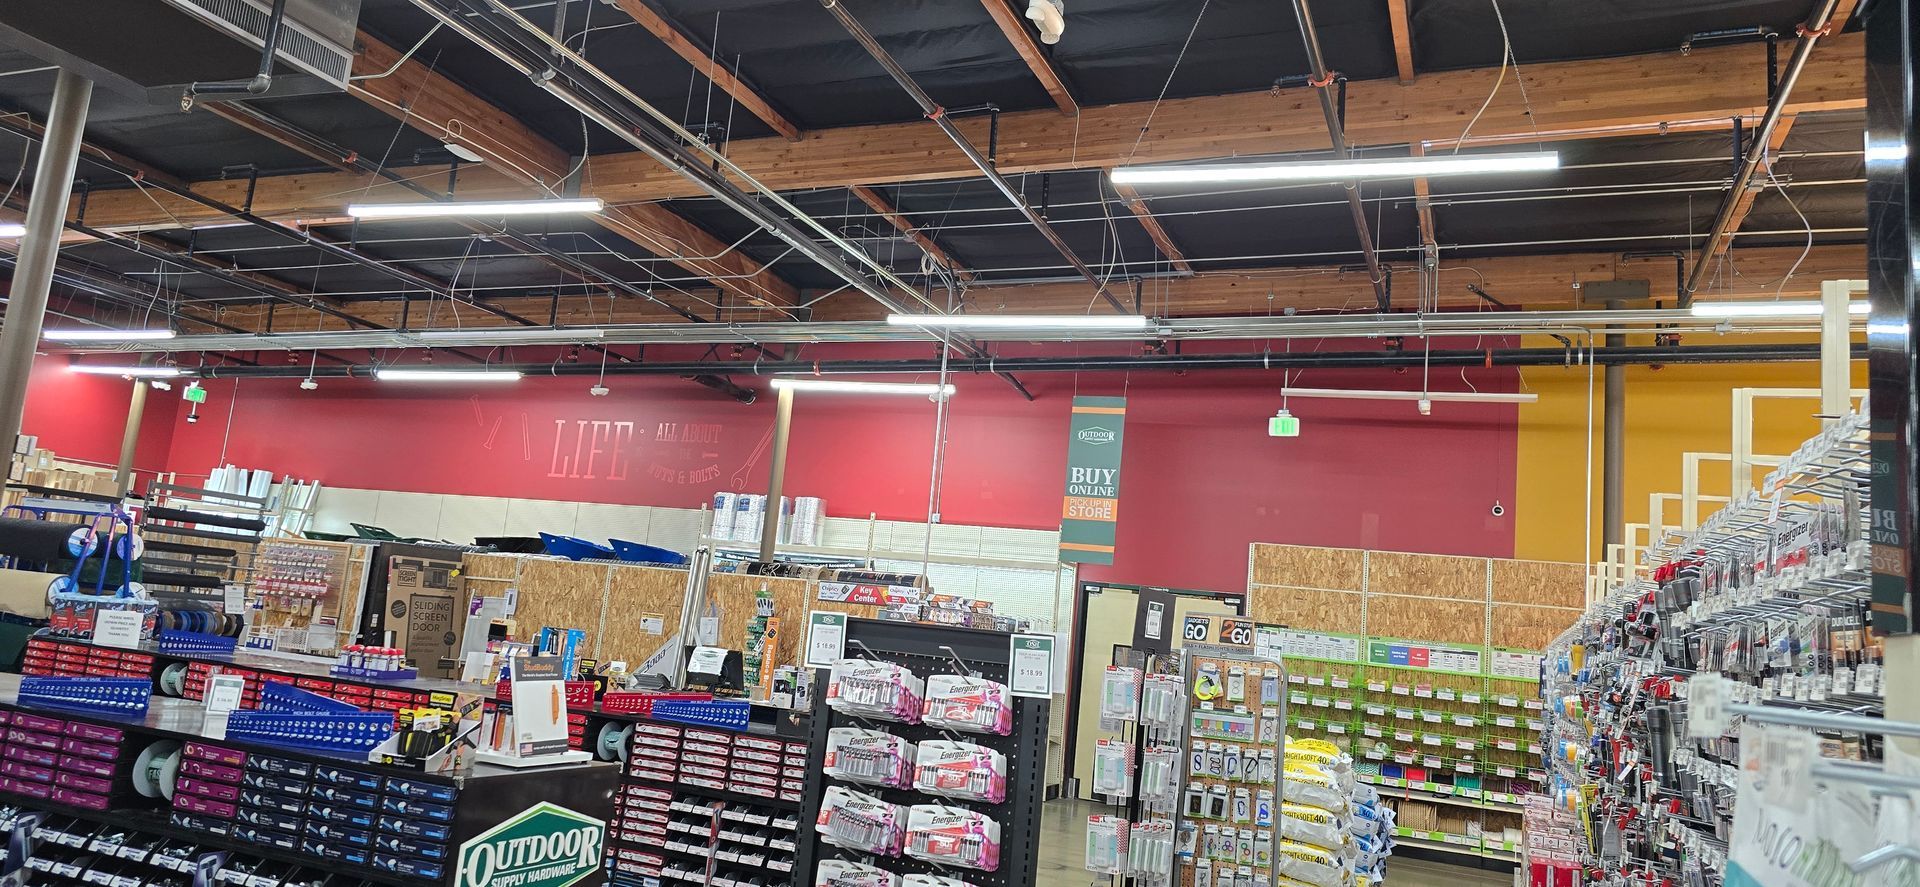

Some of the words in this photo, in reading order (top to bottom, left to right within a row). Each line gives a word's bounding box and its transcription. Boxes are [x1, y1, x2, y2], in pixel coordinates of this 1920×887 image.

[655, 423, 677, 441] ALL
[681, 423, 722, 443] ABOUT
[1078, 430, 1115, 440] OUTDOOR
[547, 419, 634, 480] LIFE
[649, 463, 674, 484] NUTS
[678, 473, 686, 483] &
[689, 464, 721, 484] BOLTS
[1070, 467, 1116, 485] BUY
[1069, 484, 1115, 497] ONLINE
[1069, 498, 1088, 507] PICK
[1069, 505, 1111, 519] STORE
[1778, 522, 1809, 546] Energizer
[859, 586, 873, 594] Key
[854, 594, 877, 603] Center
[414, 601, 450, 611] SLIDING
[414, 612, 448, 621] SCREEN
[413, 623, 440, 632] DOOR
[1185, 625, 1206, 640] GO
[1222, 621, 1235, 638] 2
[1232, 629, 1251, 645] GO
[764, 644, 774, 675] Replace
[523, 663, 555, 673] StudBuddy
[853, 666, 883, 676] Energizer
[950, 685, 980, 694] Energizer
[849, 736, 880, 747] Energizer
[940, 750, 971, 760] Energizer
[1317, 756, 1327, 764] 40
[846, 800, 876, 811] Energizer
[932, 815, 963, 825] Energizer
[1314, 815, 1323, 823] 40
[467, 826, 599, 887] OUTDOOR
[1315, 856, 1325, 865] 40
[491, 871, 526, 887] SUPPLY
[527, 862, 577, 883] HARDWARE
[840, 871, 870, 880] Energizer
